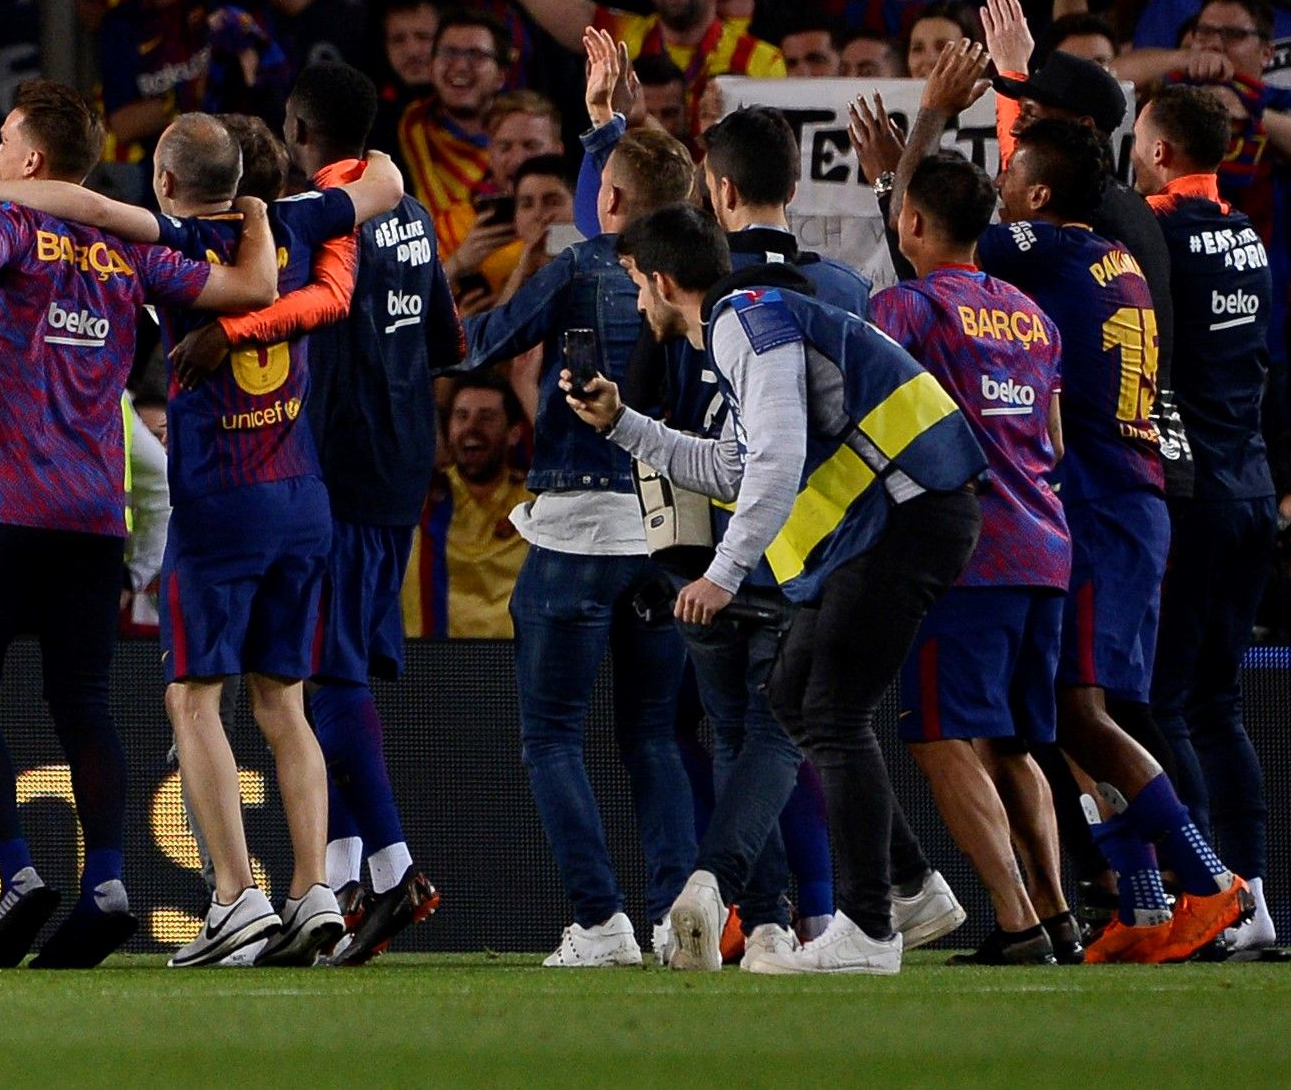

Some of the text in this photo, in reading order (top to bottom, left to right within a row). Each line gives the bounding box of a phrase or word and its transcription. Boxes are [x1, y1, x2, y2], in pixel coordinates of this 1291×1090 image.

[1211, 288, 1260, 315] beko
[47, 301, 110, 340] beko
[957, 305, 1050, 350] BARÇA
[981, 374, 1036, 406] beko
[221, 400, 285, 432] unicef
